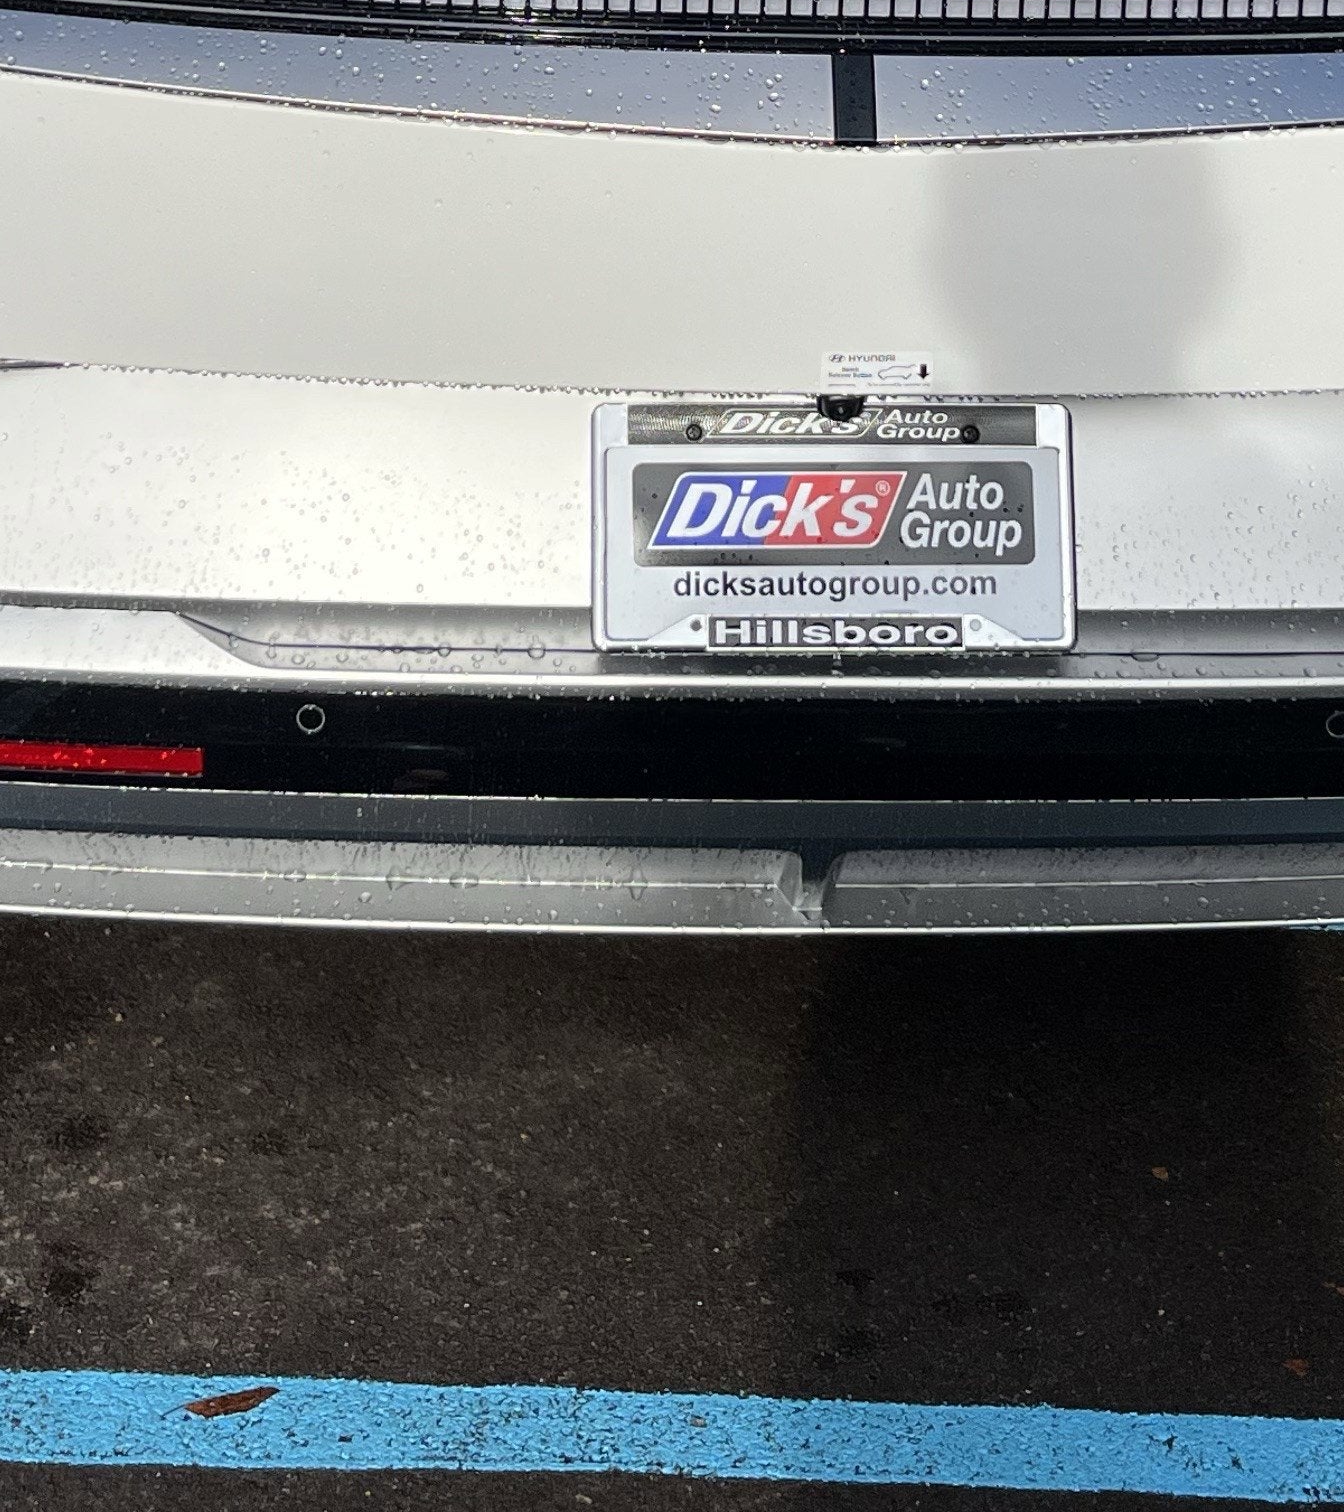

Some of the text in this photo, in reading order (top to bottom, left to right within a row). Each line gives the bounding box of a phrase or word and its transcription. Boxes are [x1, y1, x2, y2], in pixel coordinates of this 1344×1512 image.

[719, 411, 863, 435] Dicks
[883, 409, 949, 424] Auto
[876, 424, 961, 442] Group
[906, 473, 1005, 511] Auto
[900, 511, 1023, 557] Group
[673, 570, 998, 603] dicksautogroup.com
[713, 619, 959, 645] Hillsboro
